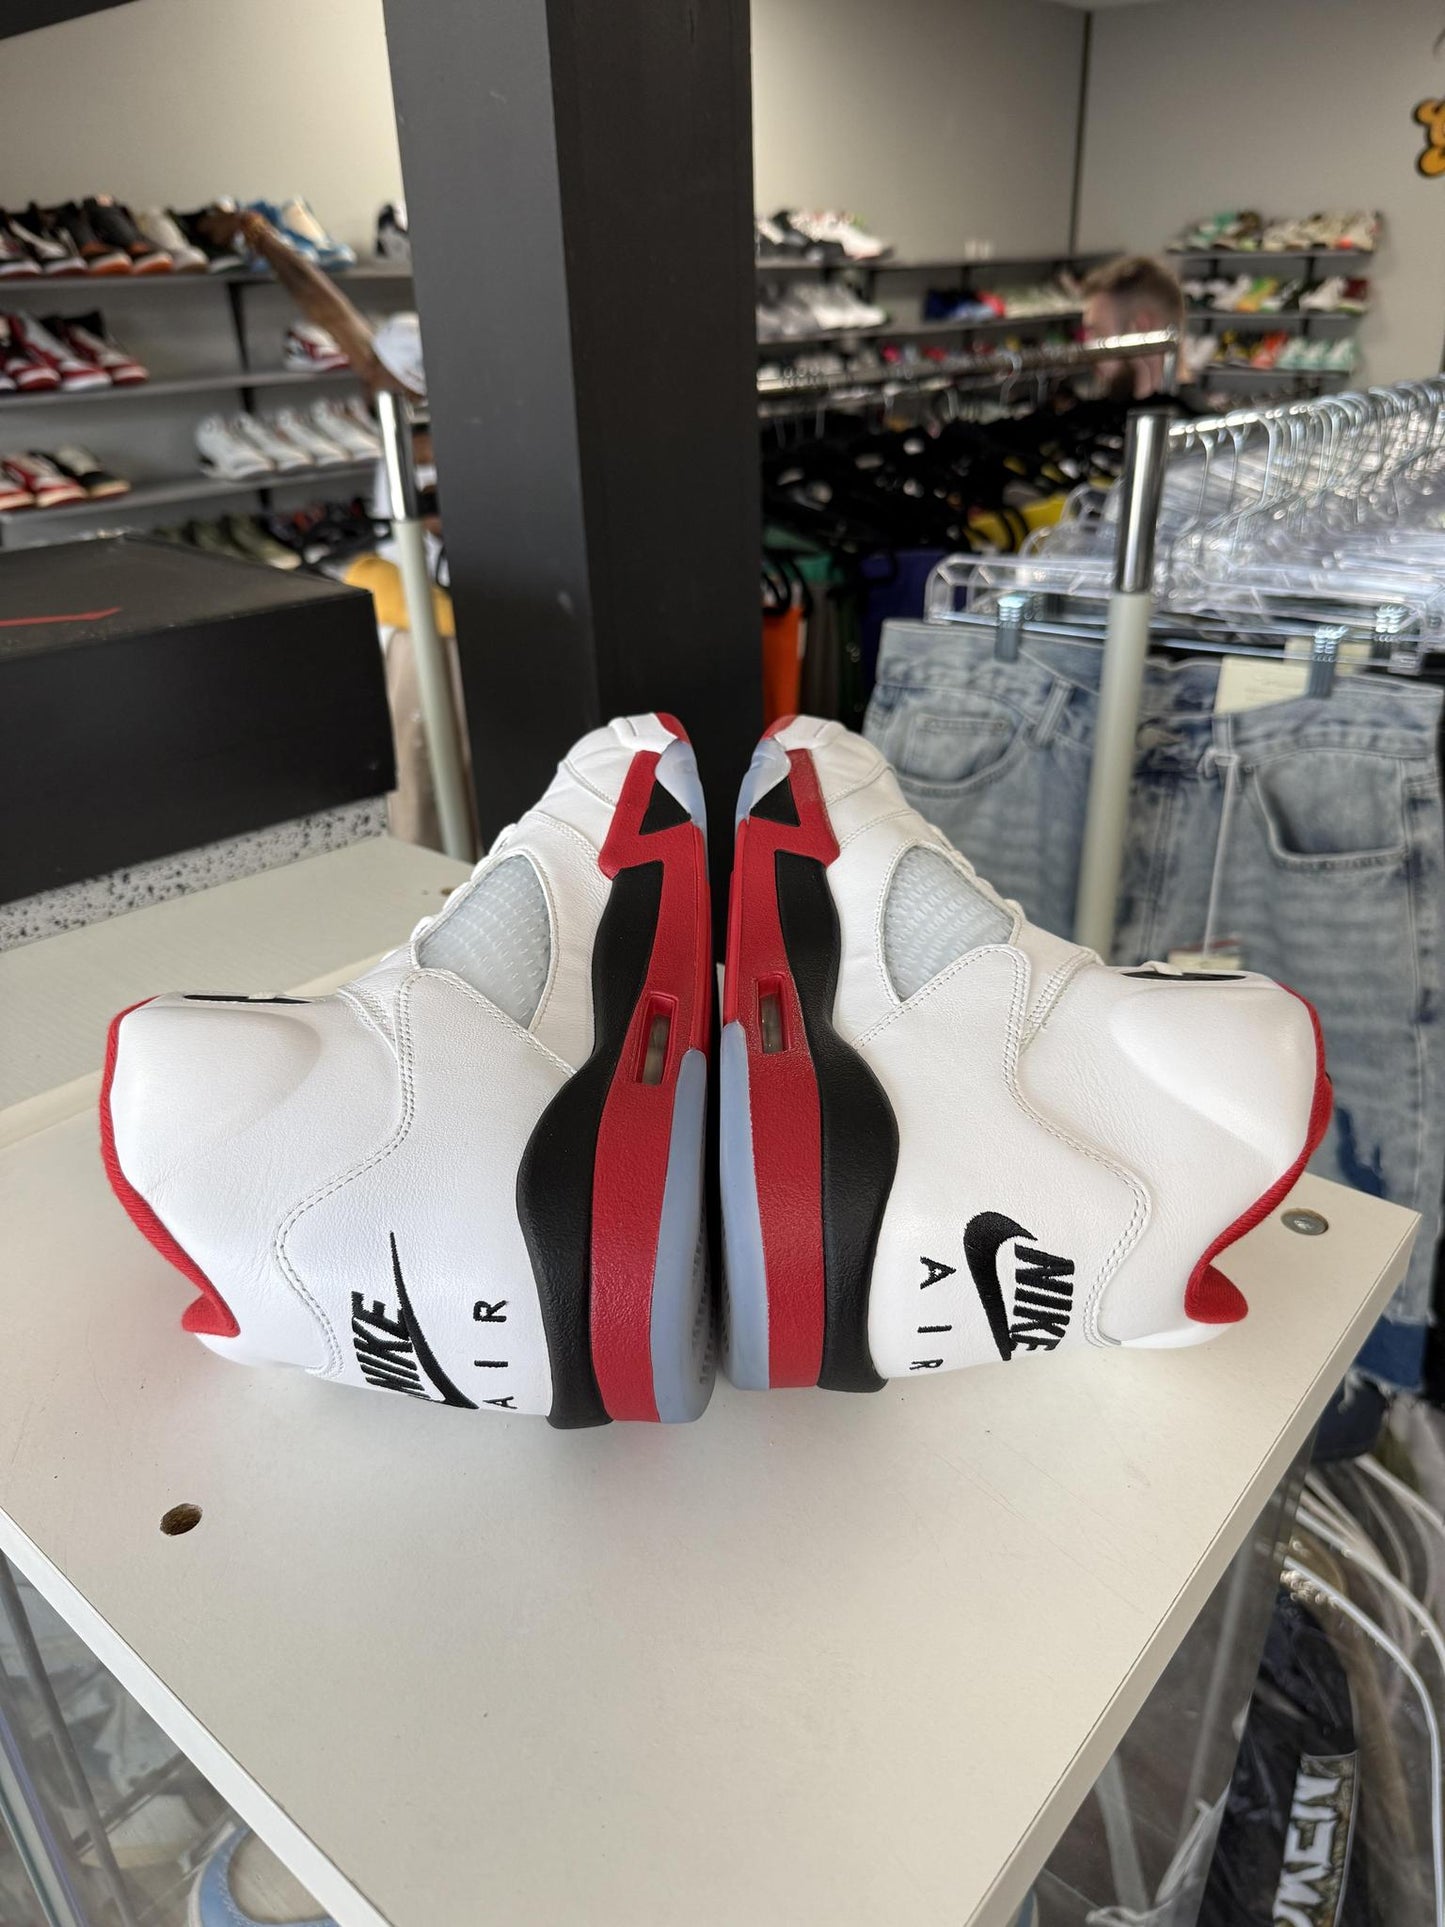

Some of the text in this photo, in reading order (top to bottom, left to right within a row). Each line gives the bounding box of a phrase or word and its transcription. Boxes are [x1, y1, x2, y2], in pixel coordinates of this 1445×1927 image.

[352, 1291, 432, 1399] NIKE
[909, 1256, 957, 1370] AIR
[1009, 1243, 1075, 1351] NIKE
[473, 1300, 518, 1409] AIR
